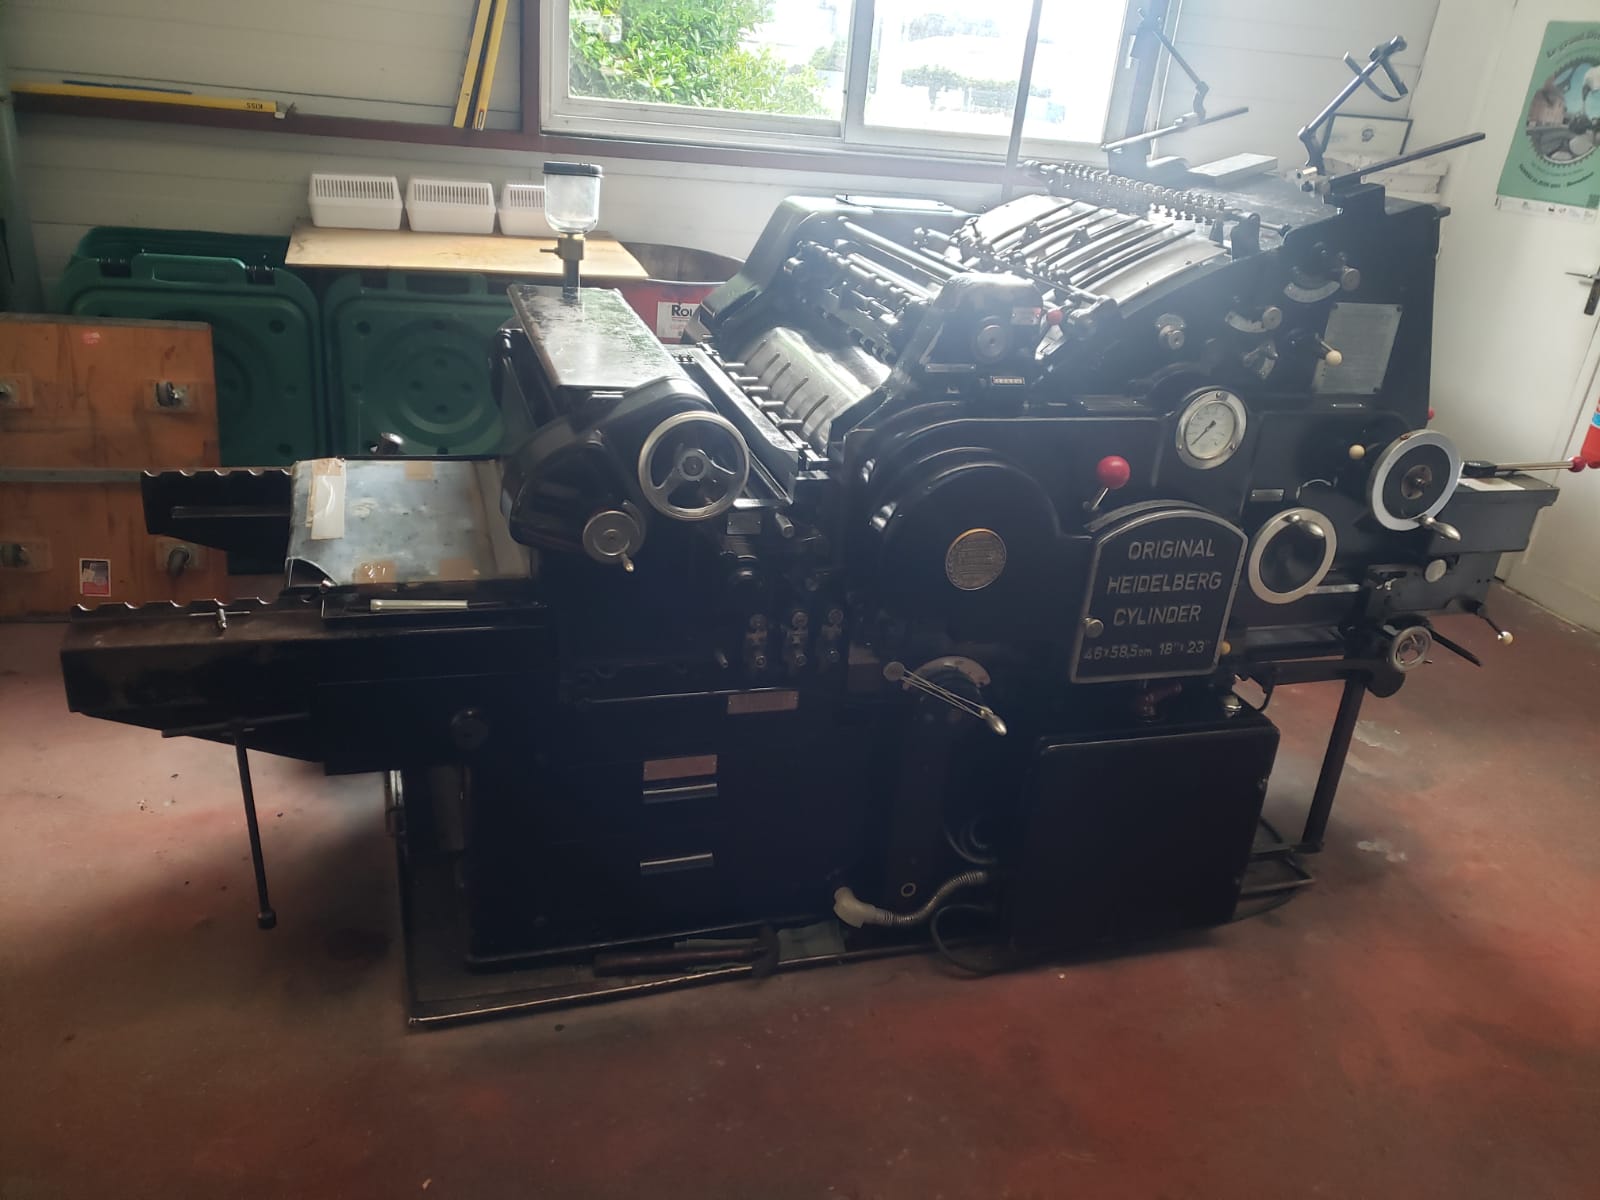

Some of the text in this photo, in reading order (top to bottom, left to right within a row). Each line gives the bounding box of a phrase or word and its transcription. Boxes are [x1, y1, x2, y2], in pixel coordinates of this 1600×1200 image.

[1128, 539, 1216, 560] ORIGINAL
[1107, 572, 1222, 595] HEIDELBERG
[1113, 605, 1202, 626] CYLINDER
